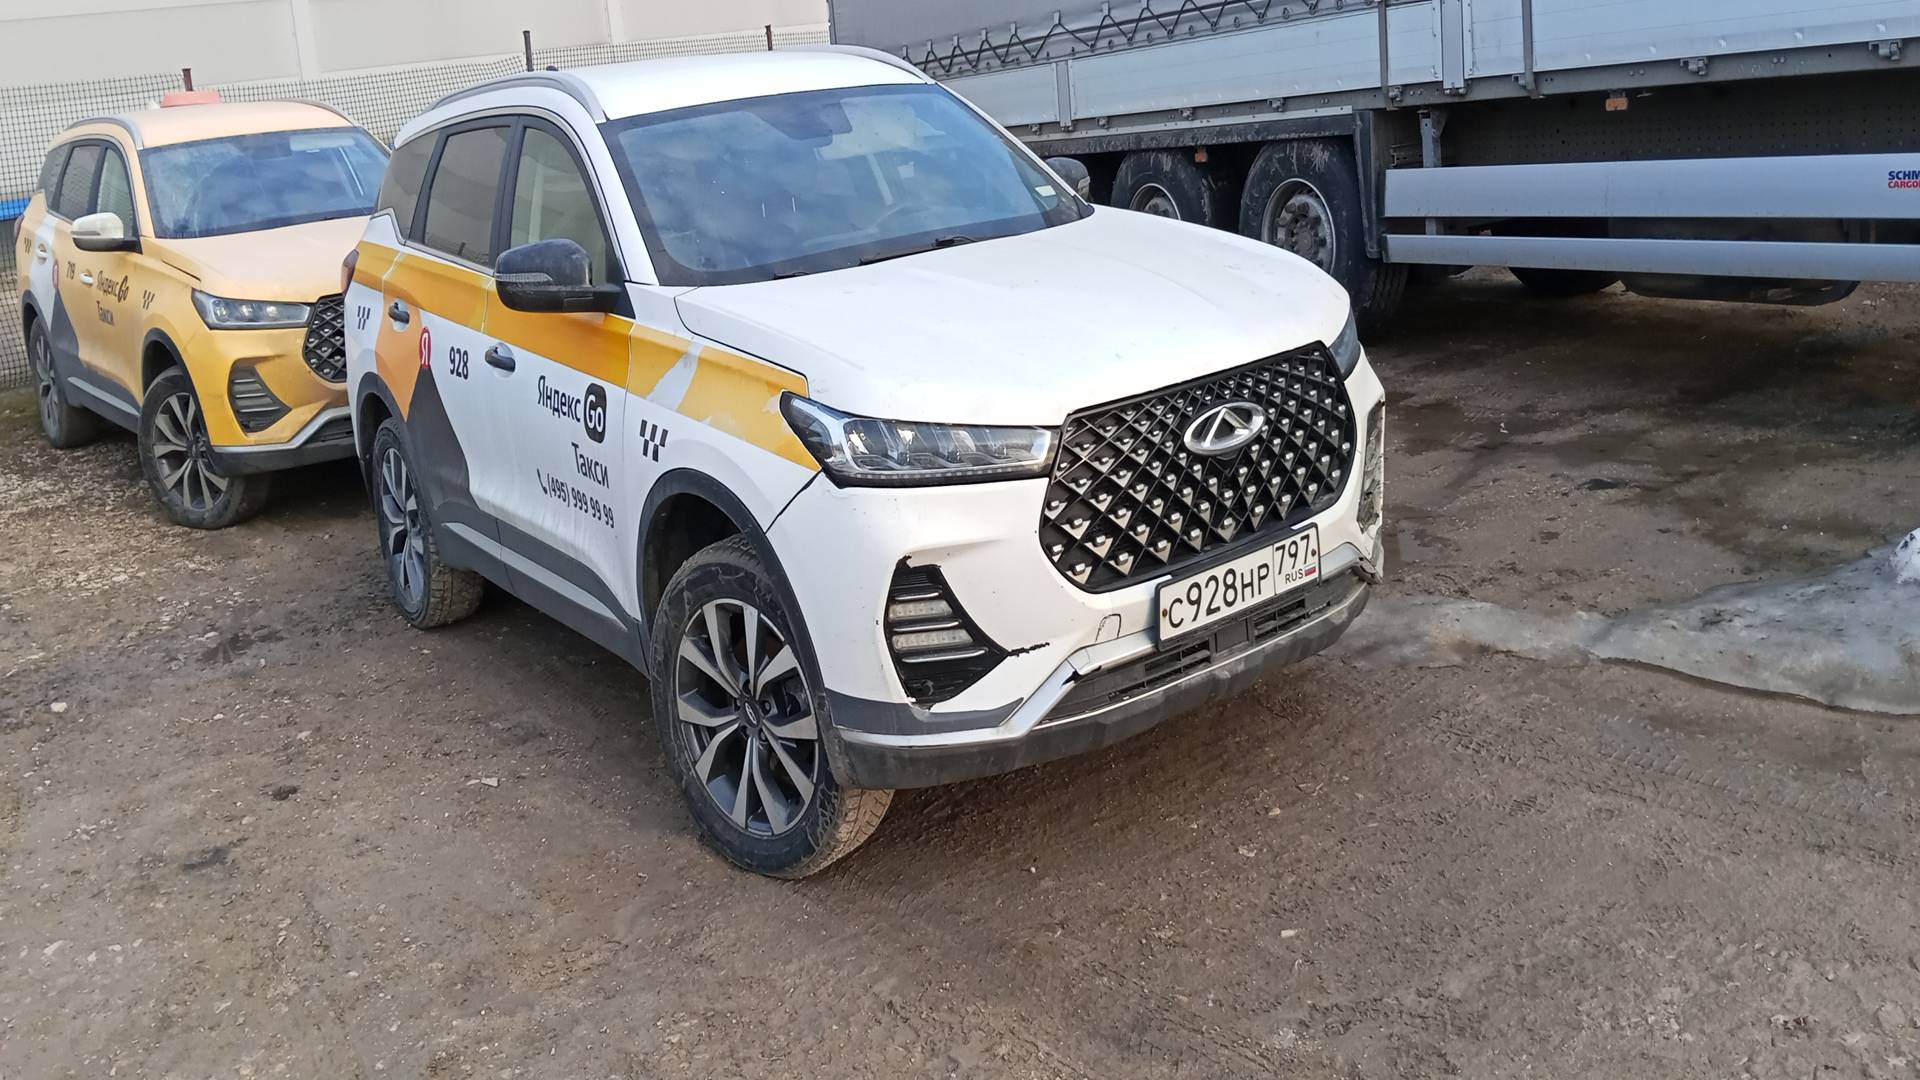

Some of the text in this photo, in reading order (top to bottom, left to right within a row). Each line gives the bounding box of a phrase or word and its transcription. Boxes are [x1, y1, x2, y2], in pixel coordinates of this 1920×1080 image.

[1888, 181, 1920, 189] CARGO
[97, 270, 129, 303] Яндекс Go
[96, 300, 115, 326] Такси
[449, 346, 469, 380] 928
[537, 375, 581, 422] Яндекс
[571, 442, 610, 489] Такси
[547, 473, 615, 529] (495) 999 99 99
[1168, 533, 1311, 629] С928НР 797
[1284, 568, 1305, 585] RUS
